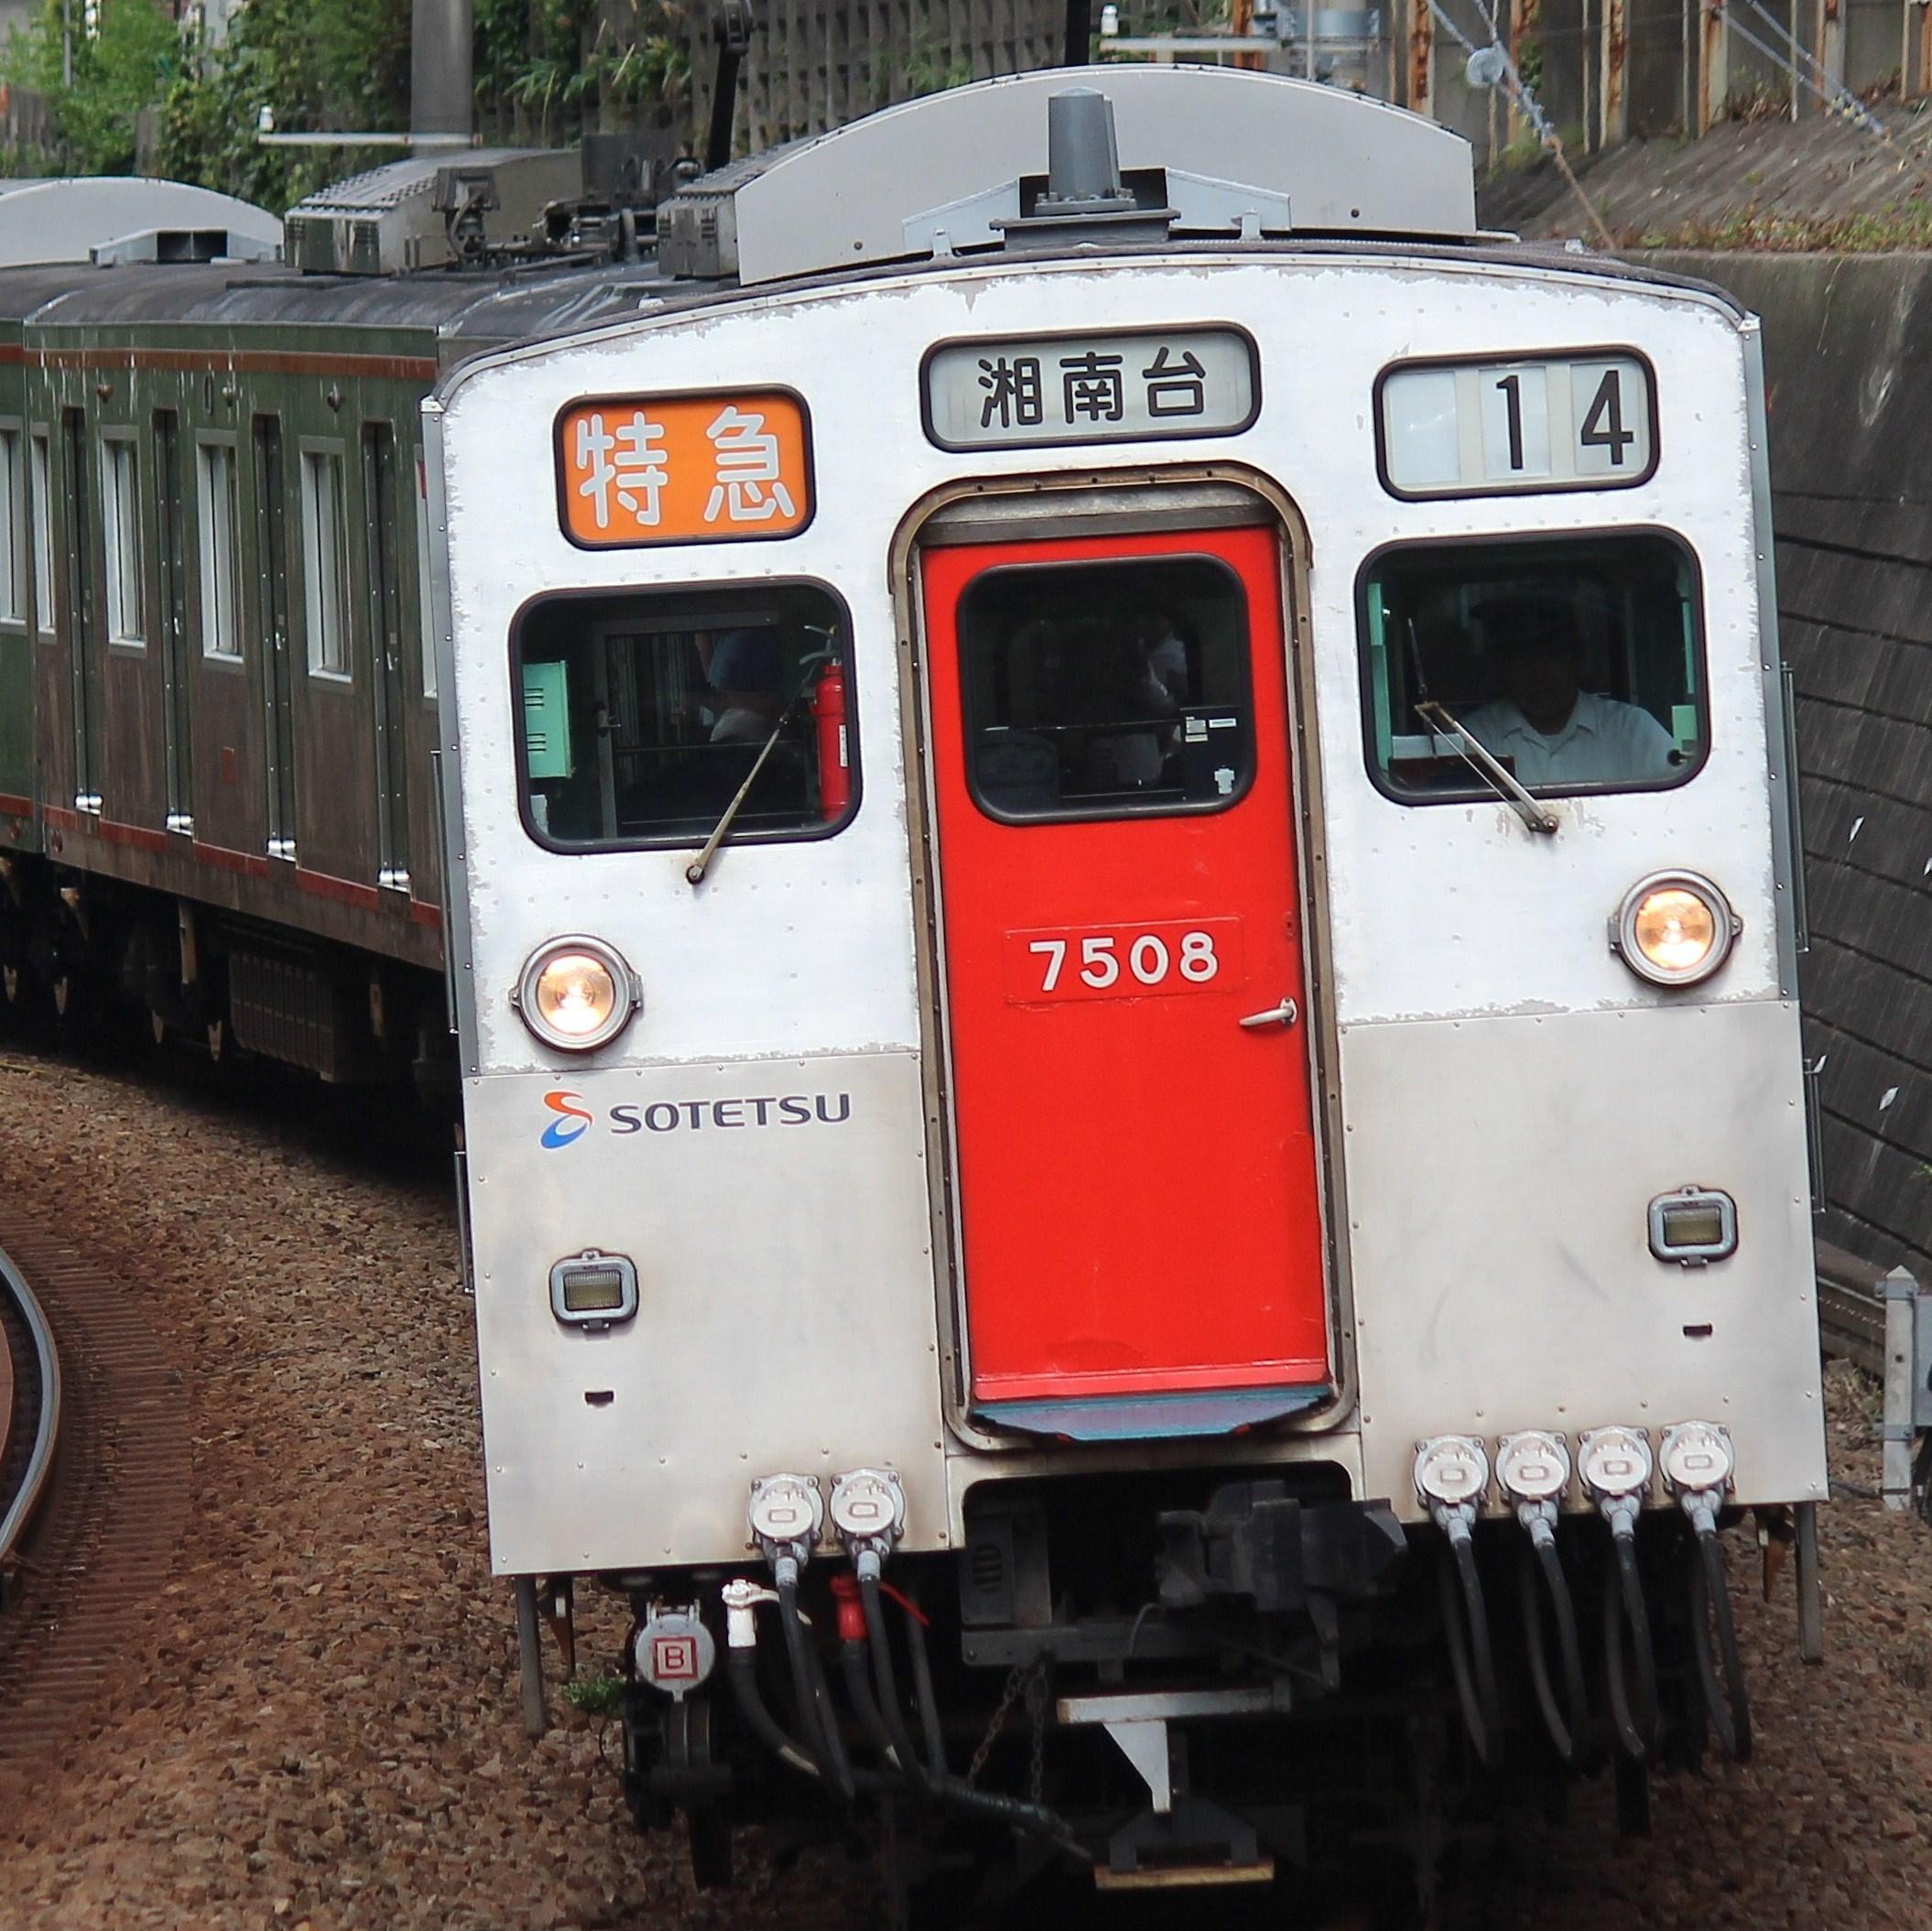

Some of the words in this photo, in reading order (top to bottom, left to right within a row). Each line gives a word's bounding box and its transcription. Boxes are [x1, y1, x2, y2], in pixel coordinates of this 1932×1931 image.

[978, 346, 1206, 428] 湘南台
[577, 405, 796, 528] 特急
[1029, 931, 1219, 993] 7508
[610, 1093, 850, 1134] SOTETSU
[665, 1646, 684, 1668] B
